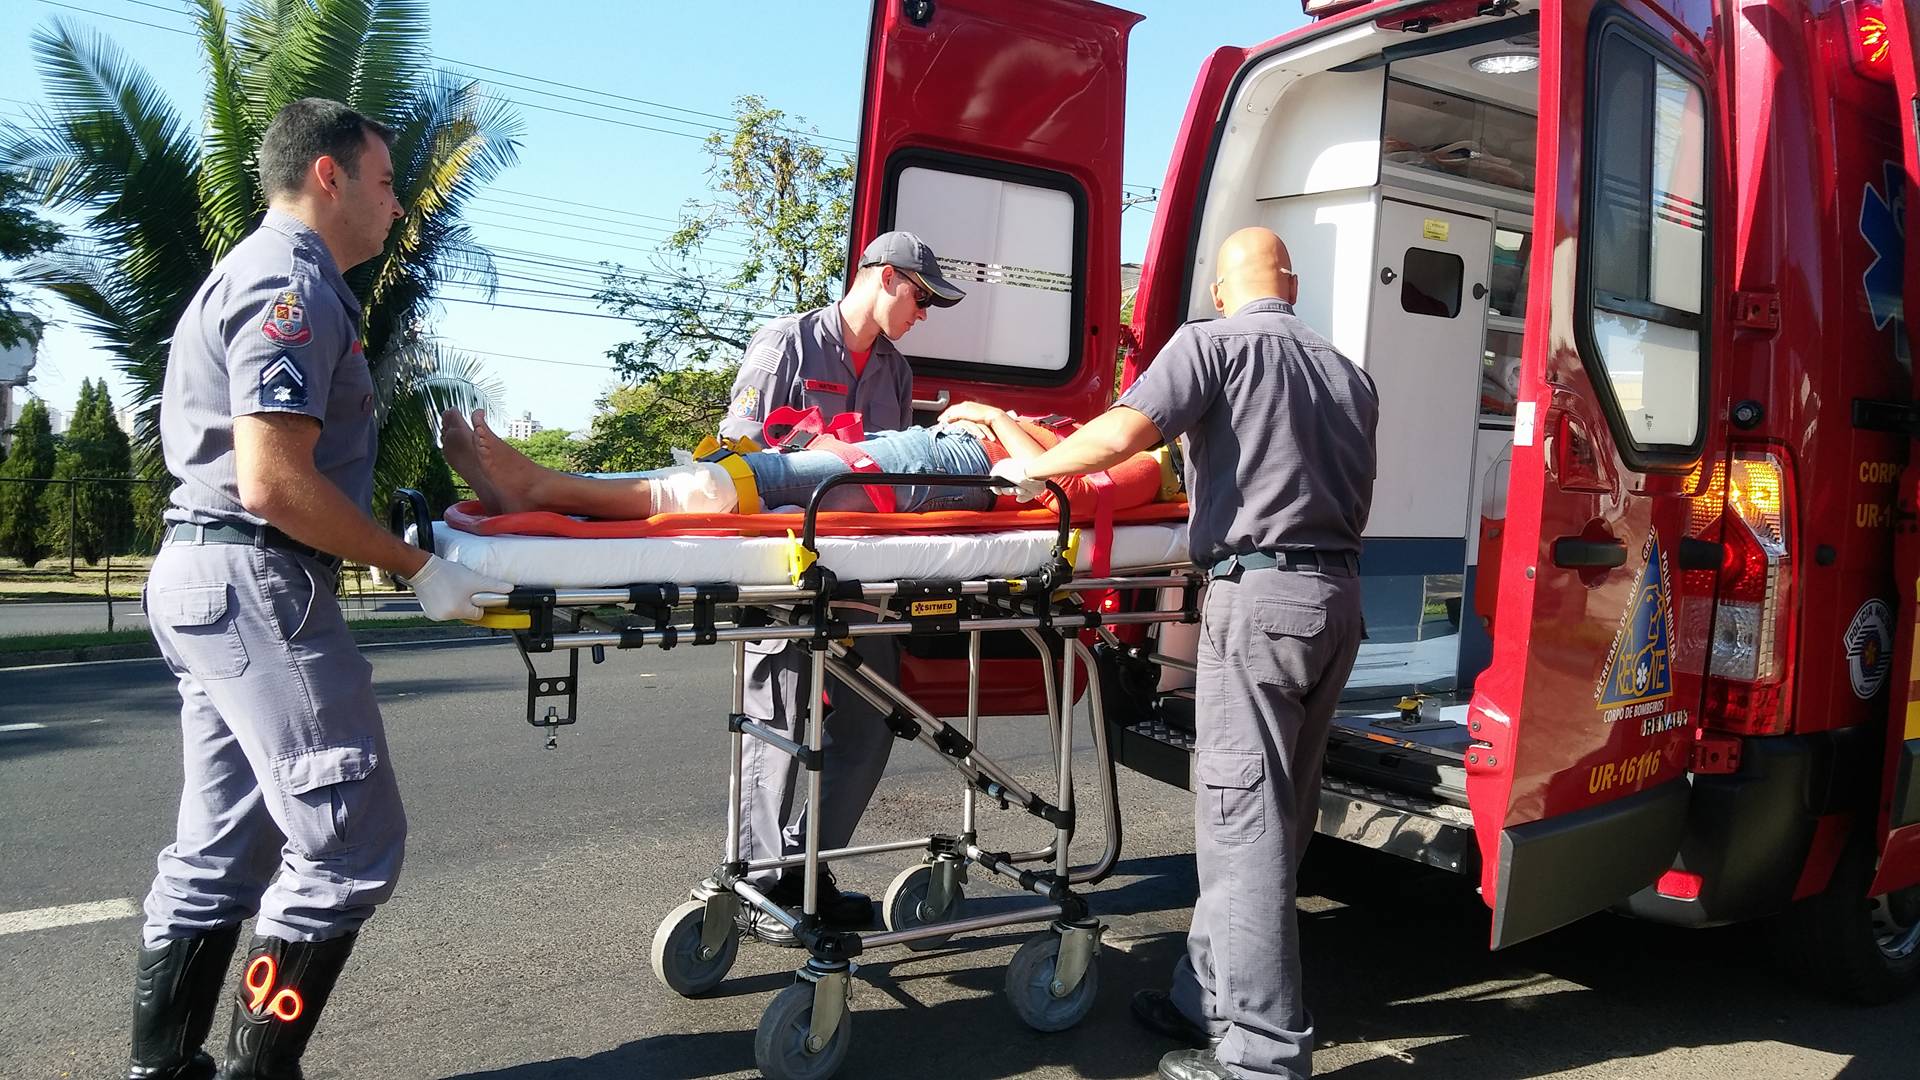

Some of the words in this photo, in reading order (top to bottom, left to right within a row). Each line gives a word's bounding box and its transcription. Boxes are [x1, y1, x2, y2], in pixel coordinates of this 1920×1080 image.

[925, 603, 952, 611] SITMED
[1594, 629, 1622, 701] SECRETARIA
[1620, 609, 1629, 627] DE
[1643, 524, 1656, 560] GRAU
[1667, 606, 1677, 663] MILITAR
[1604, 708, 1624, 723] CORPO
[1624, 705, 1634, 719] DE
[1634, 700, 1665, 718] BOMBEIROS
[1589, 749, 1661, 794] UR-16116
